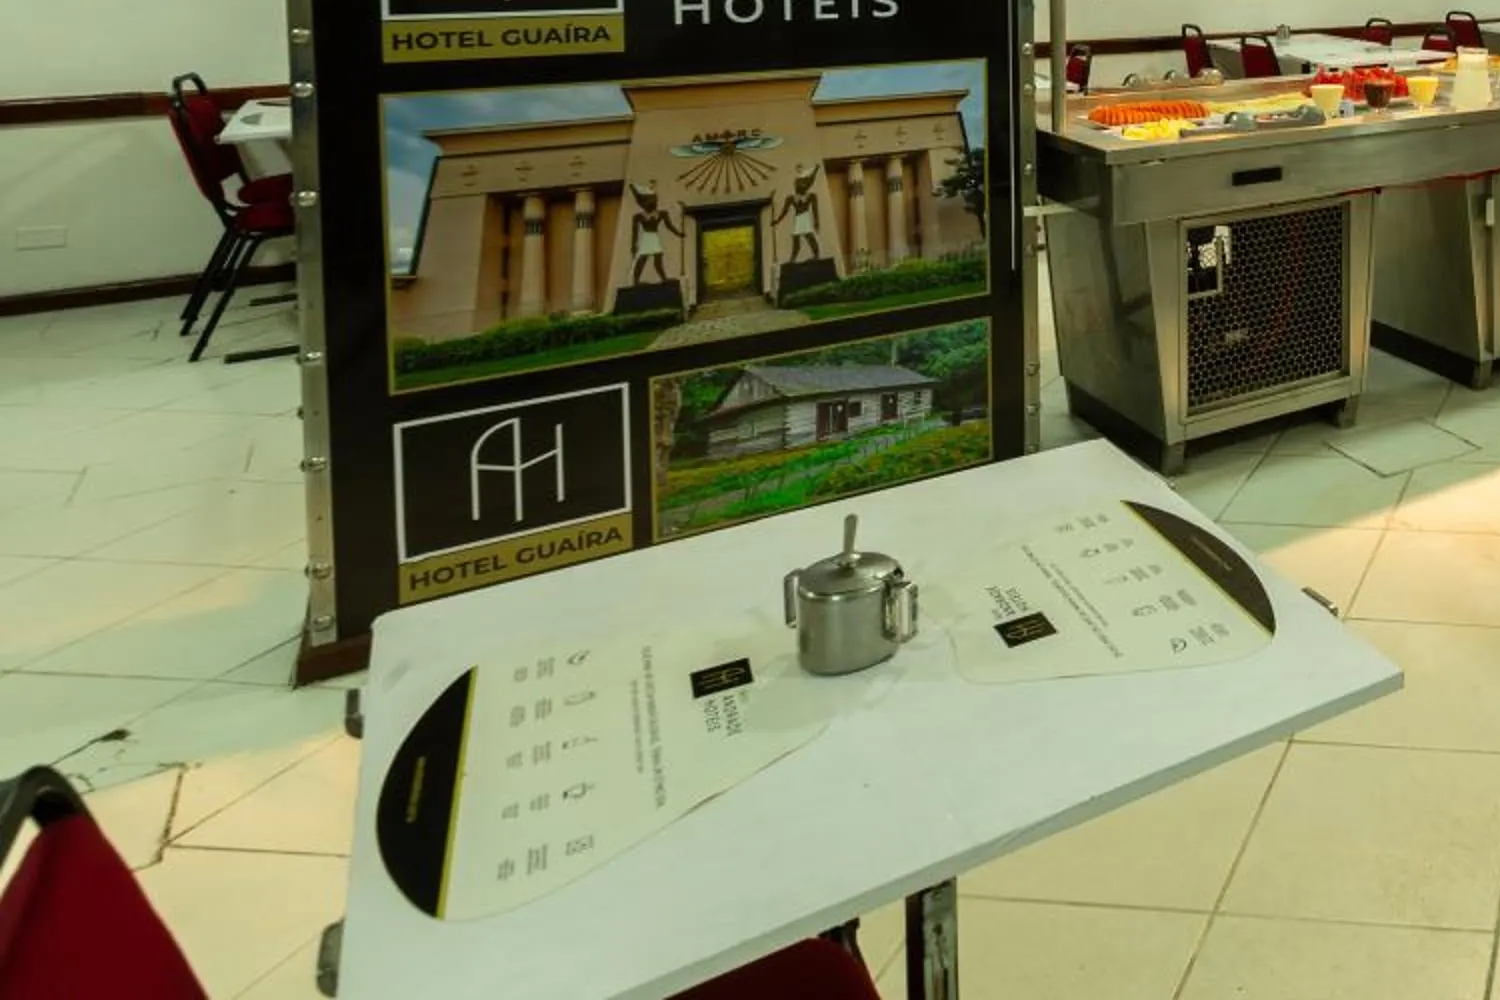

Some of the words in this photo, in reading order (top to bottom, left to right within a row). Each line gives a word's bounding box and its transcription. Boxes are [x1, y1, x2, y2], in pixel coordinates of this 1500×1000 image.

[391, 30, 491, 51] HOTEL
[501, 24, 611, 47] GUAÍRA
[409, 552, 508, 590] HOTEL
[515, 526, 624, 564] GUAÍRA
